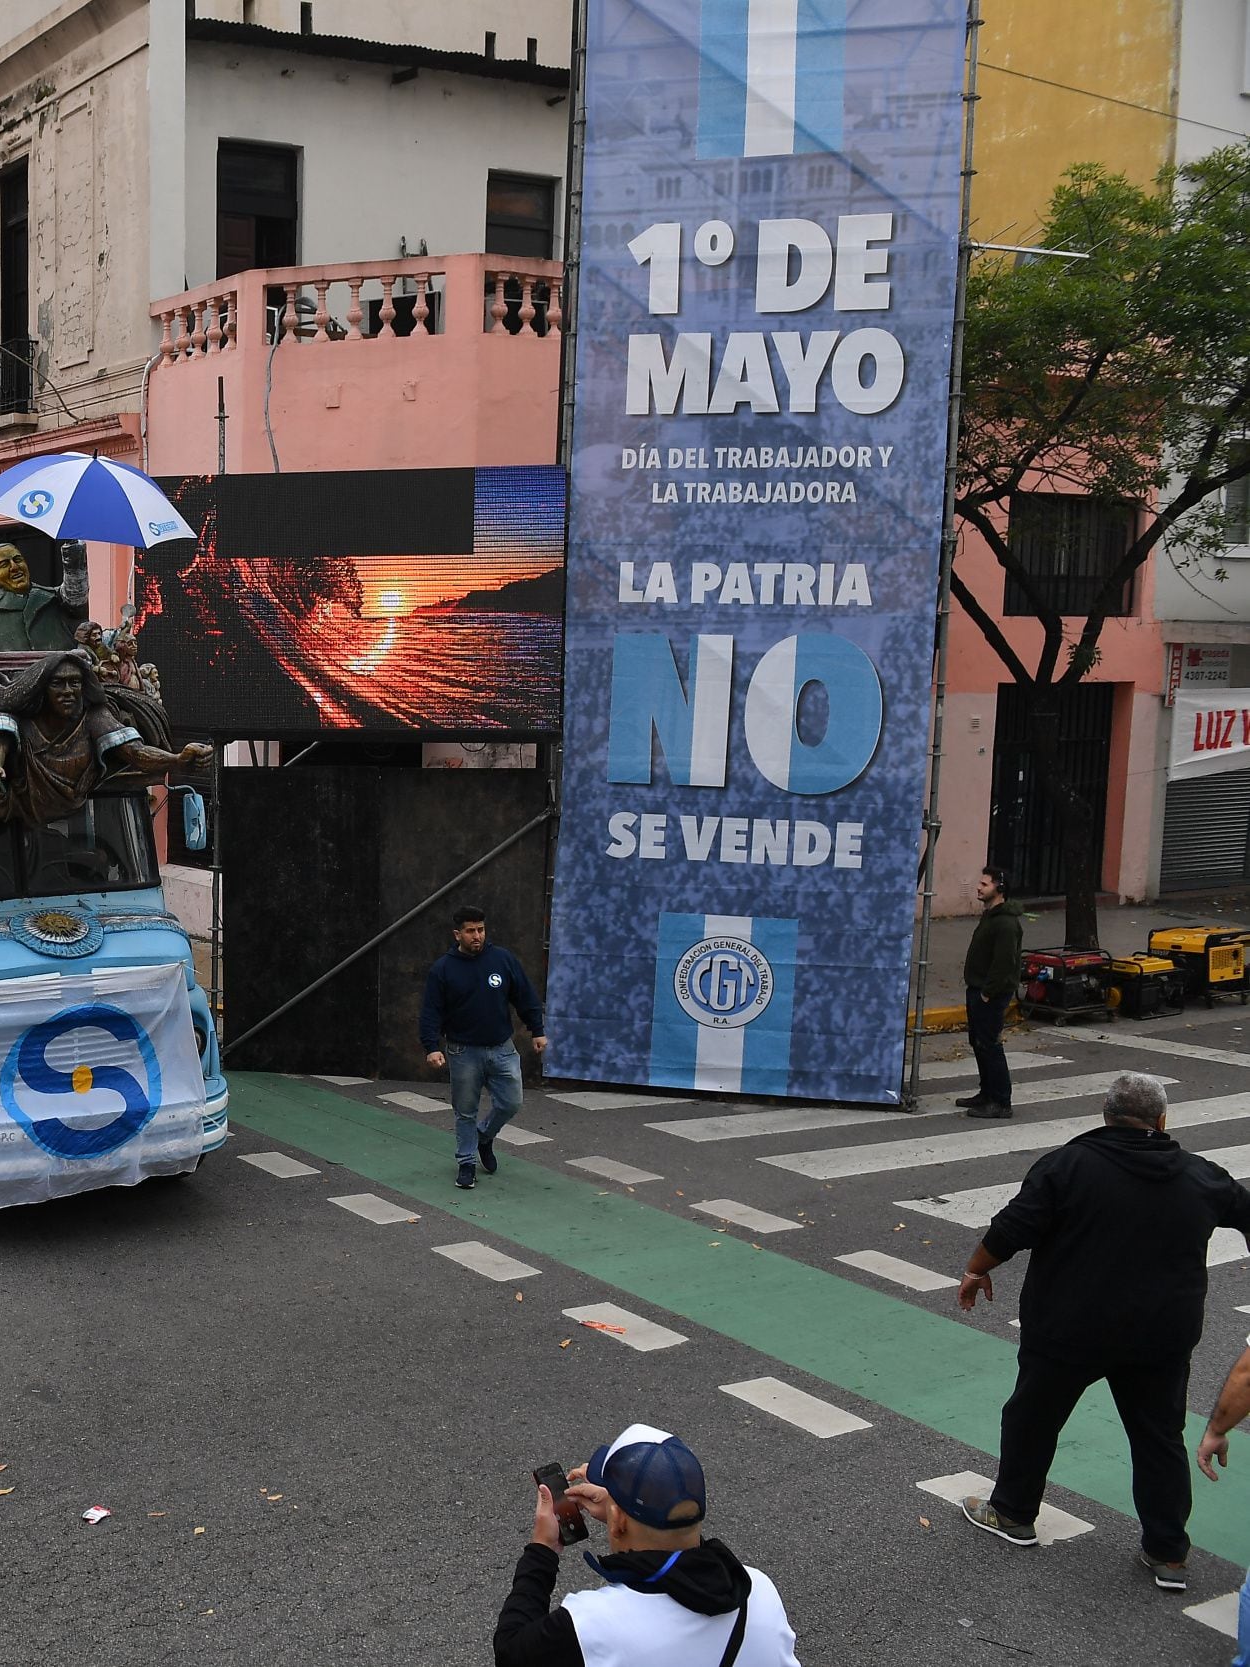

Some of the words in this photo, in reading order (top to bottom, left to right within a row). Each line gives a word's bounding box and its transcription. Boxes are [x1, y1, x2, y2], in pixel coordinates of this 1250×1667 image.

[755, 212, 893, 314] DE
[625, 327, 905, 416] MAYO
[621, 443, 664, 470] DÍA
[667, 447, 709, 470] DEL
[714, 446, 871, 469] TRABAJADOR
[877, 445, 894, 468] Y
[651, 482, 679, 504] LA
[684, 481, 857, 504] TRABAJADORA
[618, 561, 678, 604] LA
[690, 562, 872, 606] PATRIA
[606, 632, 884, 795] NO
[1193, 709, 1236, 752] LUZ
[604, 811, 667, 860] SE
[680, 814, 864, 869] VENDE
[713, 941, 751, 957] GENERAL
[750, 954, 764, 970] DEL
[678, 943, 712, 1000] CONFEDERACION
[692, 954, 754, 1011] CGT
[755, 969, 769, 1005] TRABAJO
[713, 1016, 730, 1025] R.A.
